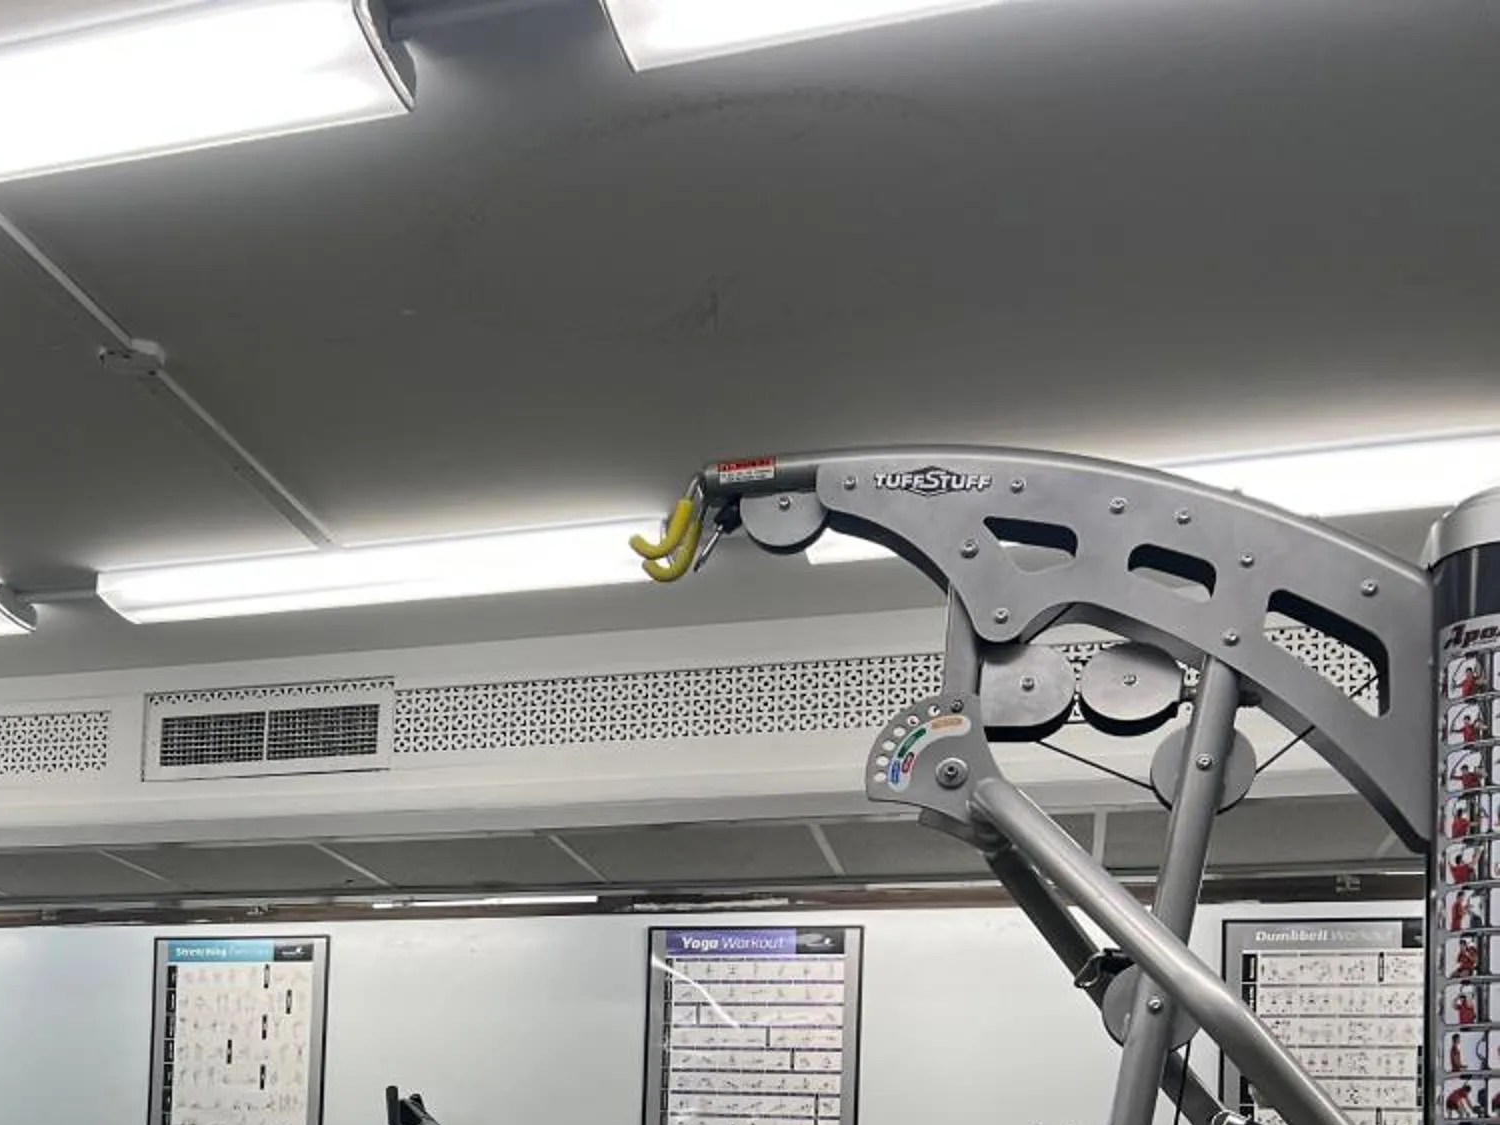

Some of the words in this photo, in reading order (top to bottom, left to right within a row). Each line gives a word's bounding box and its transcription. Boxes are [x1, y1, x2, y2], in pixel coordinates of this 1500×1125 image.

[874, 469, 992, 490] TUFFSTUFF
[1255, 929, 1328, 941] Dumbbell
[682, 936, 718, 951] Yoga
[721, 936, 785, 949] Workout
